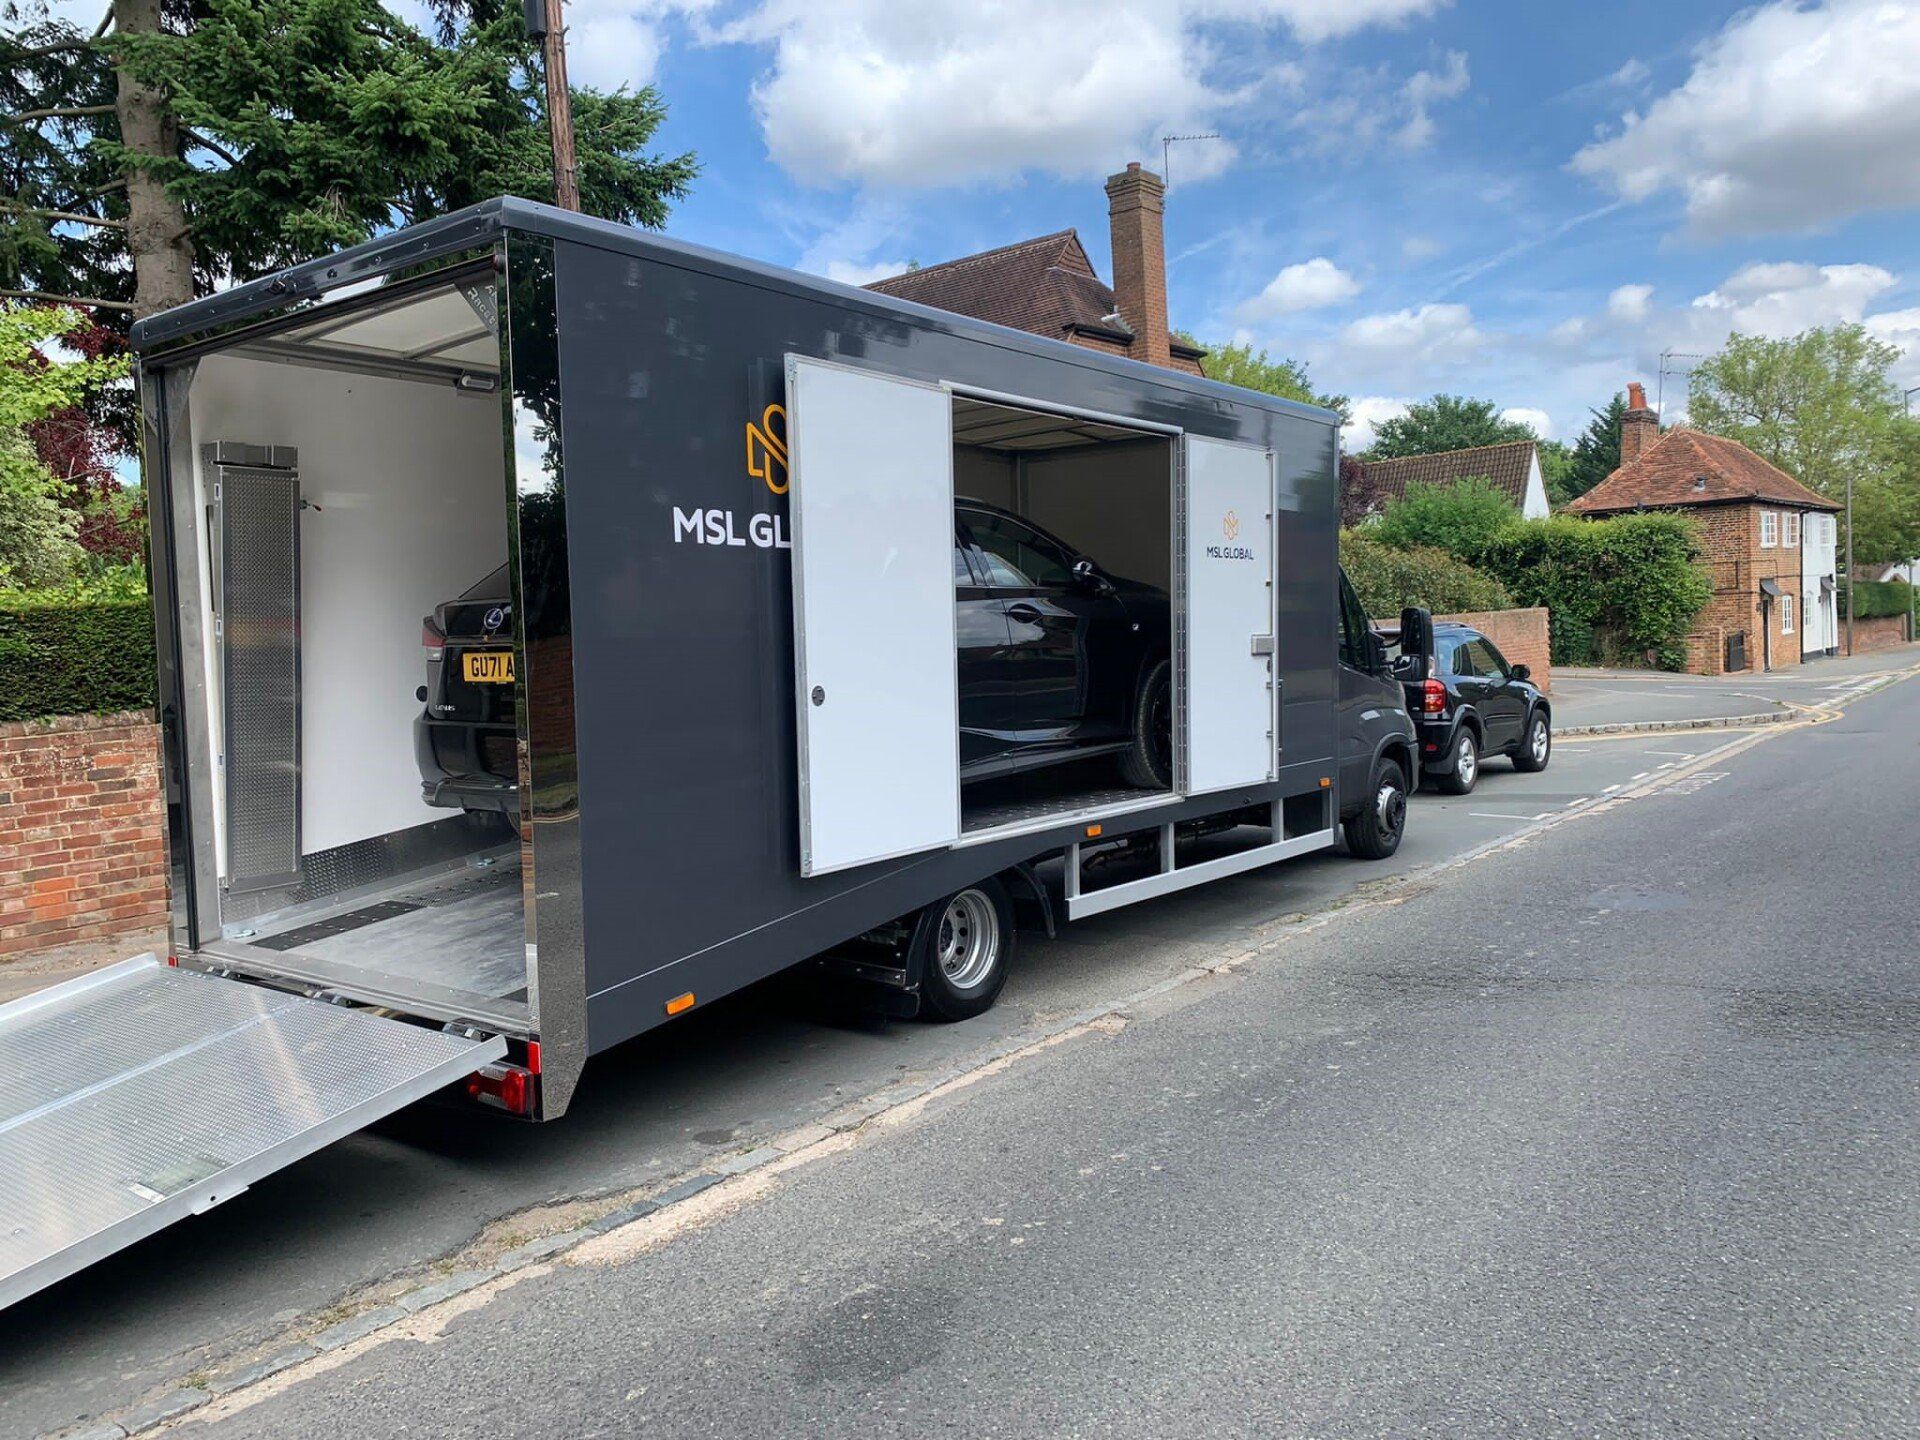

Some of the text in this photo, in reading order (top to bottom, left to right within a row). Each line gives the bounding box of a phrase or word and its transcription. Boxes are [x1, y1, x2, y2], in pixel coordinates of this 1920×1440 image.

[673, 506, 746, 546] MSL
[1206, 546, 1254, 560] MSL GLOBAL
[471, 656, 501, 677] GU71
